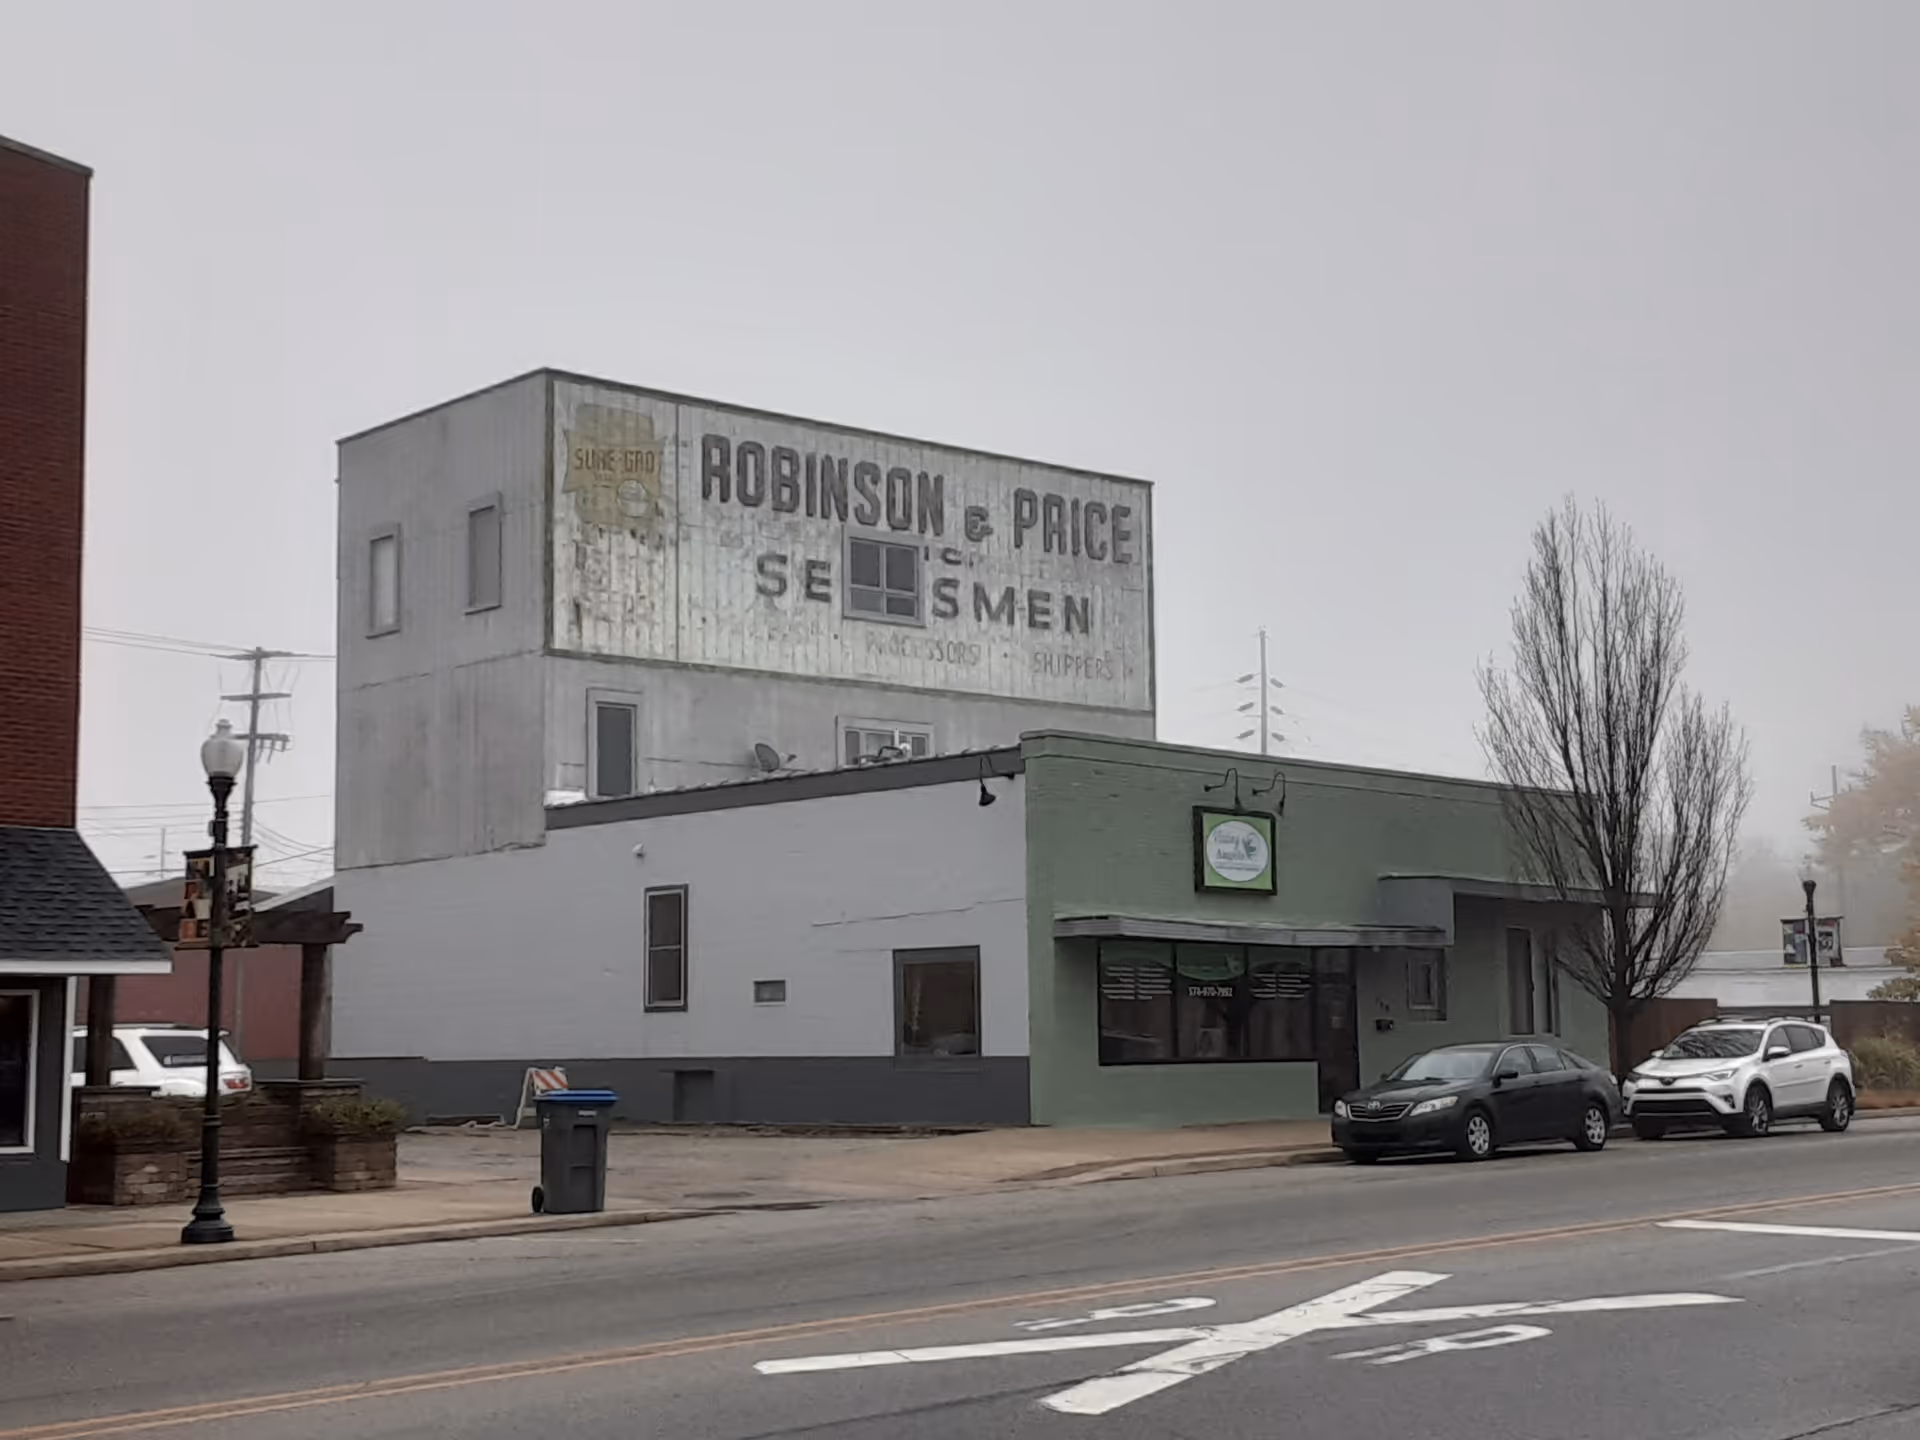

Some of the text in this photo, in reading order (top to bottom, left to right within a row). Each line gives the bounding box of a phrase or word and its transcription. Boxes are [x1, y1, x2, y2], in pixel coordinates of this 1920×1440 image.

[701, 433, 1133, 564] ROBINSON & PRICE
[756, 552, 1090, 634] SESMEN
[1033, 649, 1114, 681] SHIPPERS
